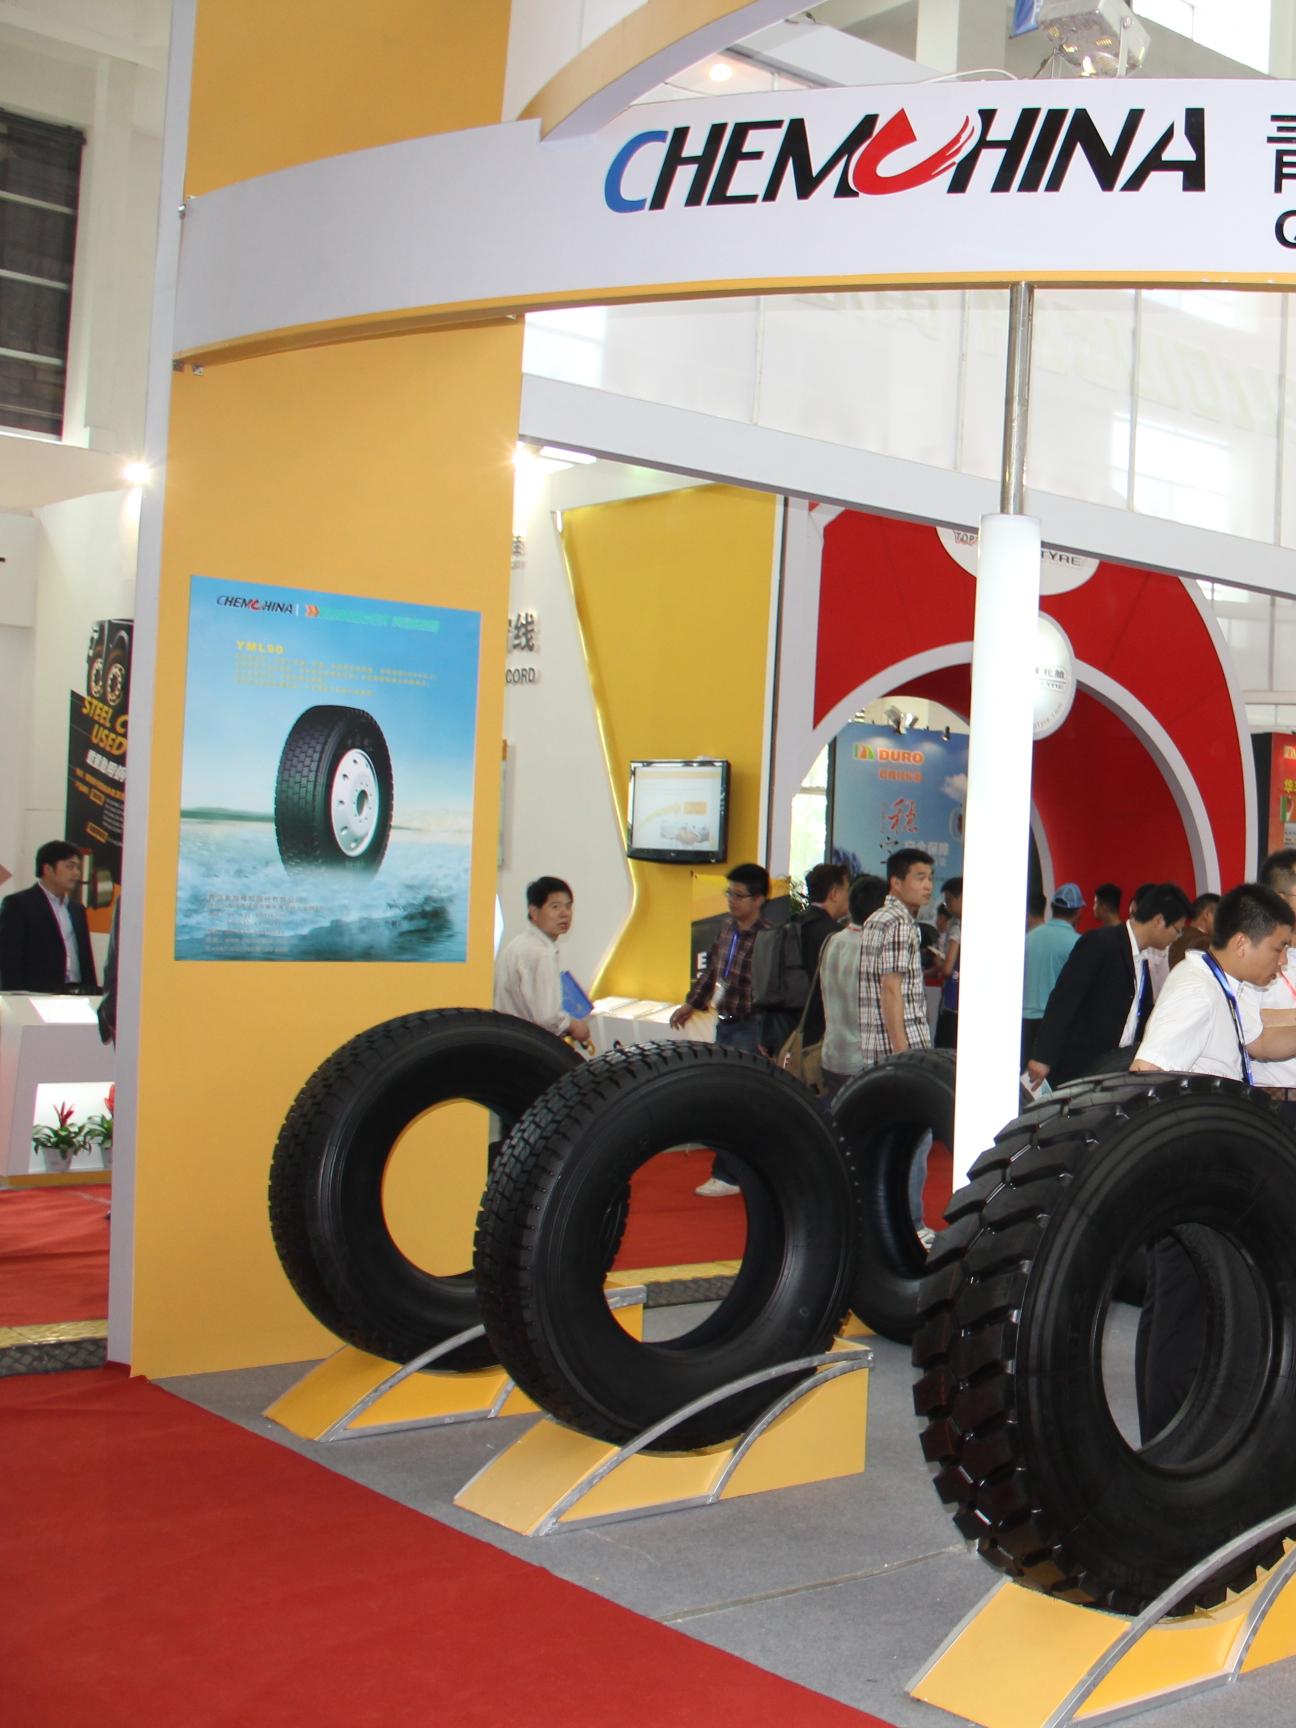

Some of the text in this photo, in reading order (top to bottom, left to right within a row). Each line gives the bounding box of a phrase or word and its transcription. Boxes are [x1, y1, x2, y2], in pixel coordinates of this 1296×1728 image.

[603, 107, 1206, 214] CHEMCHINA
[215, 595, 293, 615] CHEMCHINA
[508, 612, 535, 652] 线
[505, 667, 536, 685] CORD
[82, 695, 113, 727] STEEL
[91, 723, 128, 756] USED
[878, 748, 924, 766] DURO
